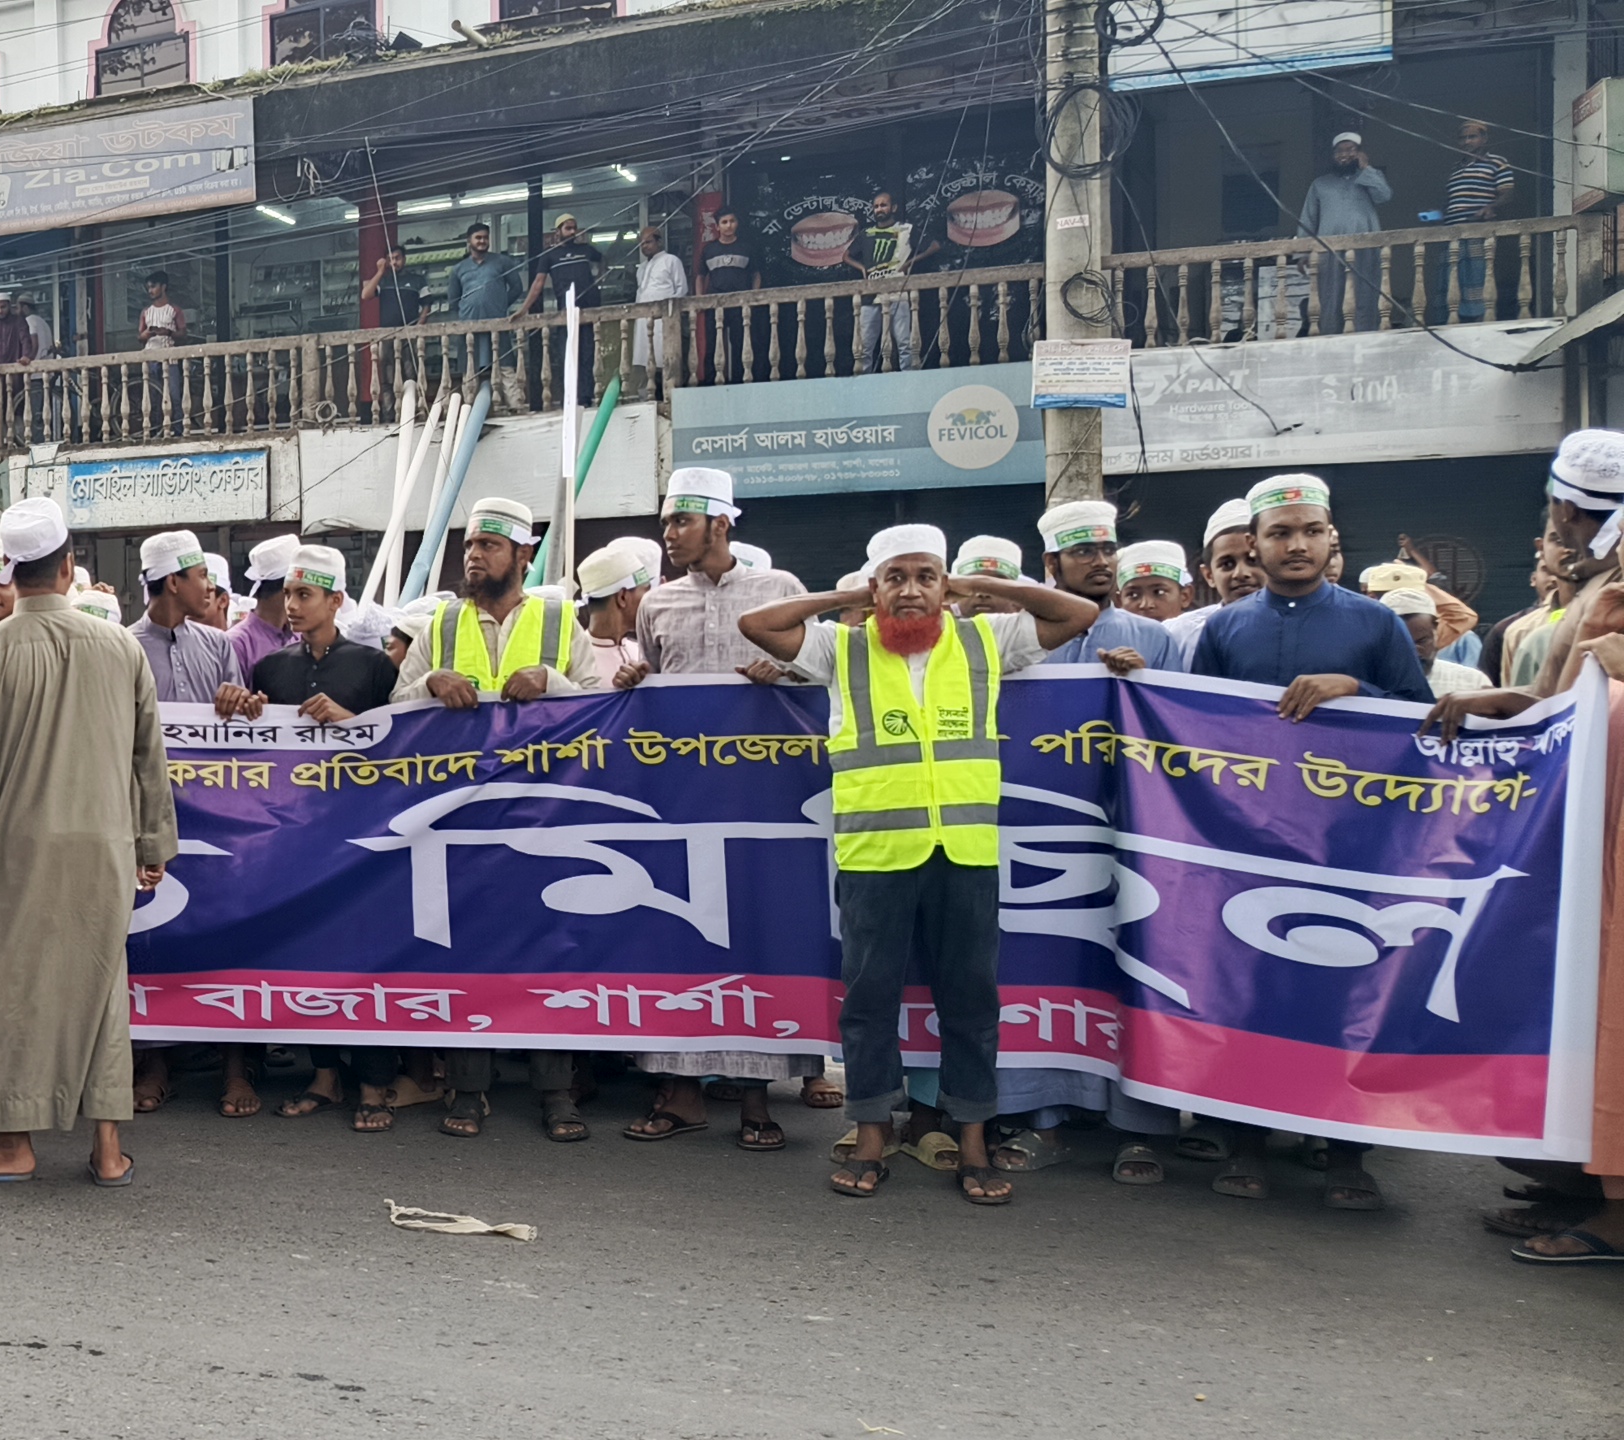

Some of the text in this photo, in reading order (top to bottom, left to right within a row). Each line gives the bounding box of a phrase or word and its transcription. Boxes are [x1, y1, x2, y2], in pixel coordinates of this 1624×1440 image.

[97, 113, 244, 154] ডটকম
[24, 151, 202, 190] Zia.Com
[1169, 403, 1225, 414] Hardware
[692, 427, 750, 454] মেসার্স
[753, 429, 807, 449] আলম
[938, 424, 1008, 442] FEVICOL
[70, 467, 138, 501] মোবাইল
[161, 719, 282, 745] হমানির
[289, 749, 482, 791] প্রতিবাদে
[500, 728, 611, 776] শার্শা
[623, 726, 833, 768] উপজেল
[1030, 720, 1280, 793] পরিষদের
[193, 980, 493, 1032] বাজার,
[528, 974, 801, 1038] শার্শা,
